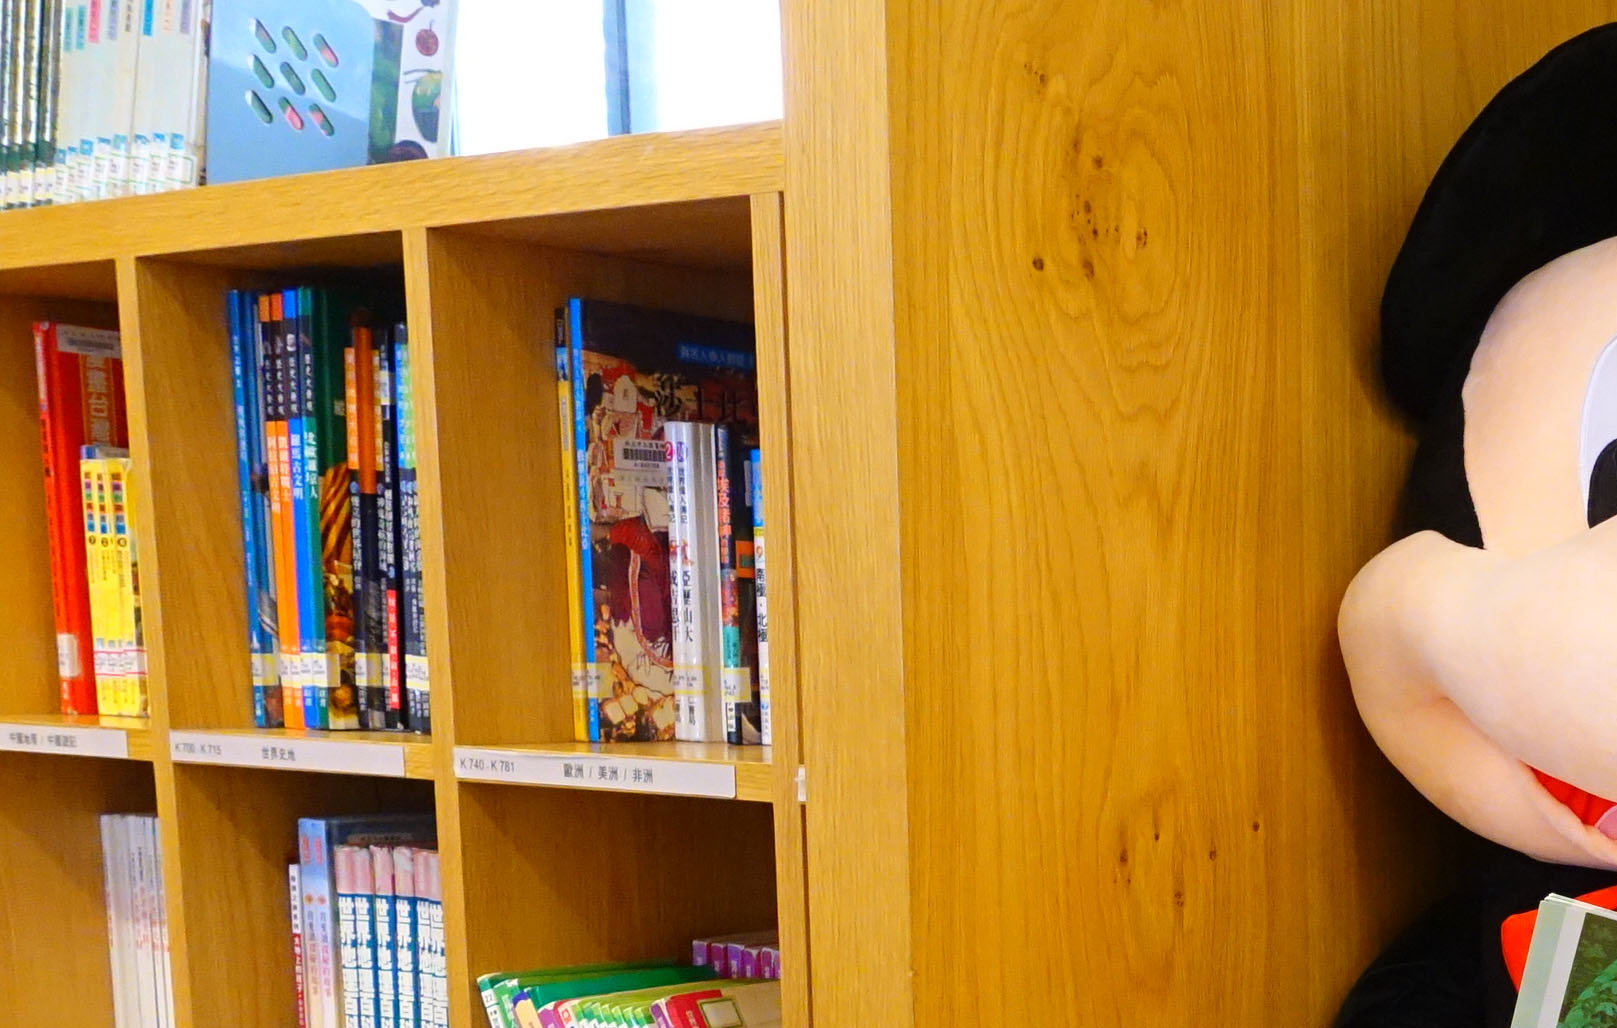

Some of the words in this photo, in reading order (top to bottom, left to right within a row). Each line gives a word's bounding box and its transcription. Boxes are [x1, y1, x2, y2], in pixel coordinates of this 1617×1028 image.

[292, 434, 304, 500] 羅馬古文明
[682, 570, 693, 642] 亞歷山大
[261, 746, 296, 761] 世界史地
[469, 759, 484, 770] 740
[500, 760, 515, 772] 781
[563, 763, 584, 779] 歐洲
[598, 766, 618, 781] 美洲
[632, 768, 653, 784] 非洲
